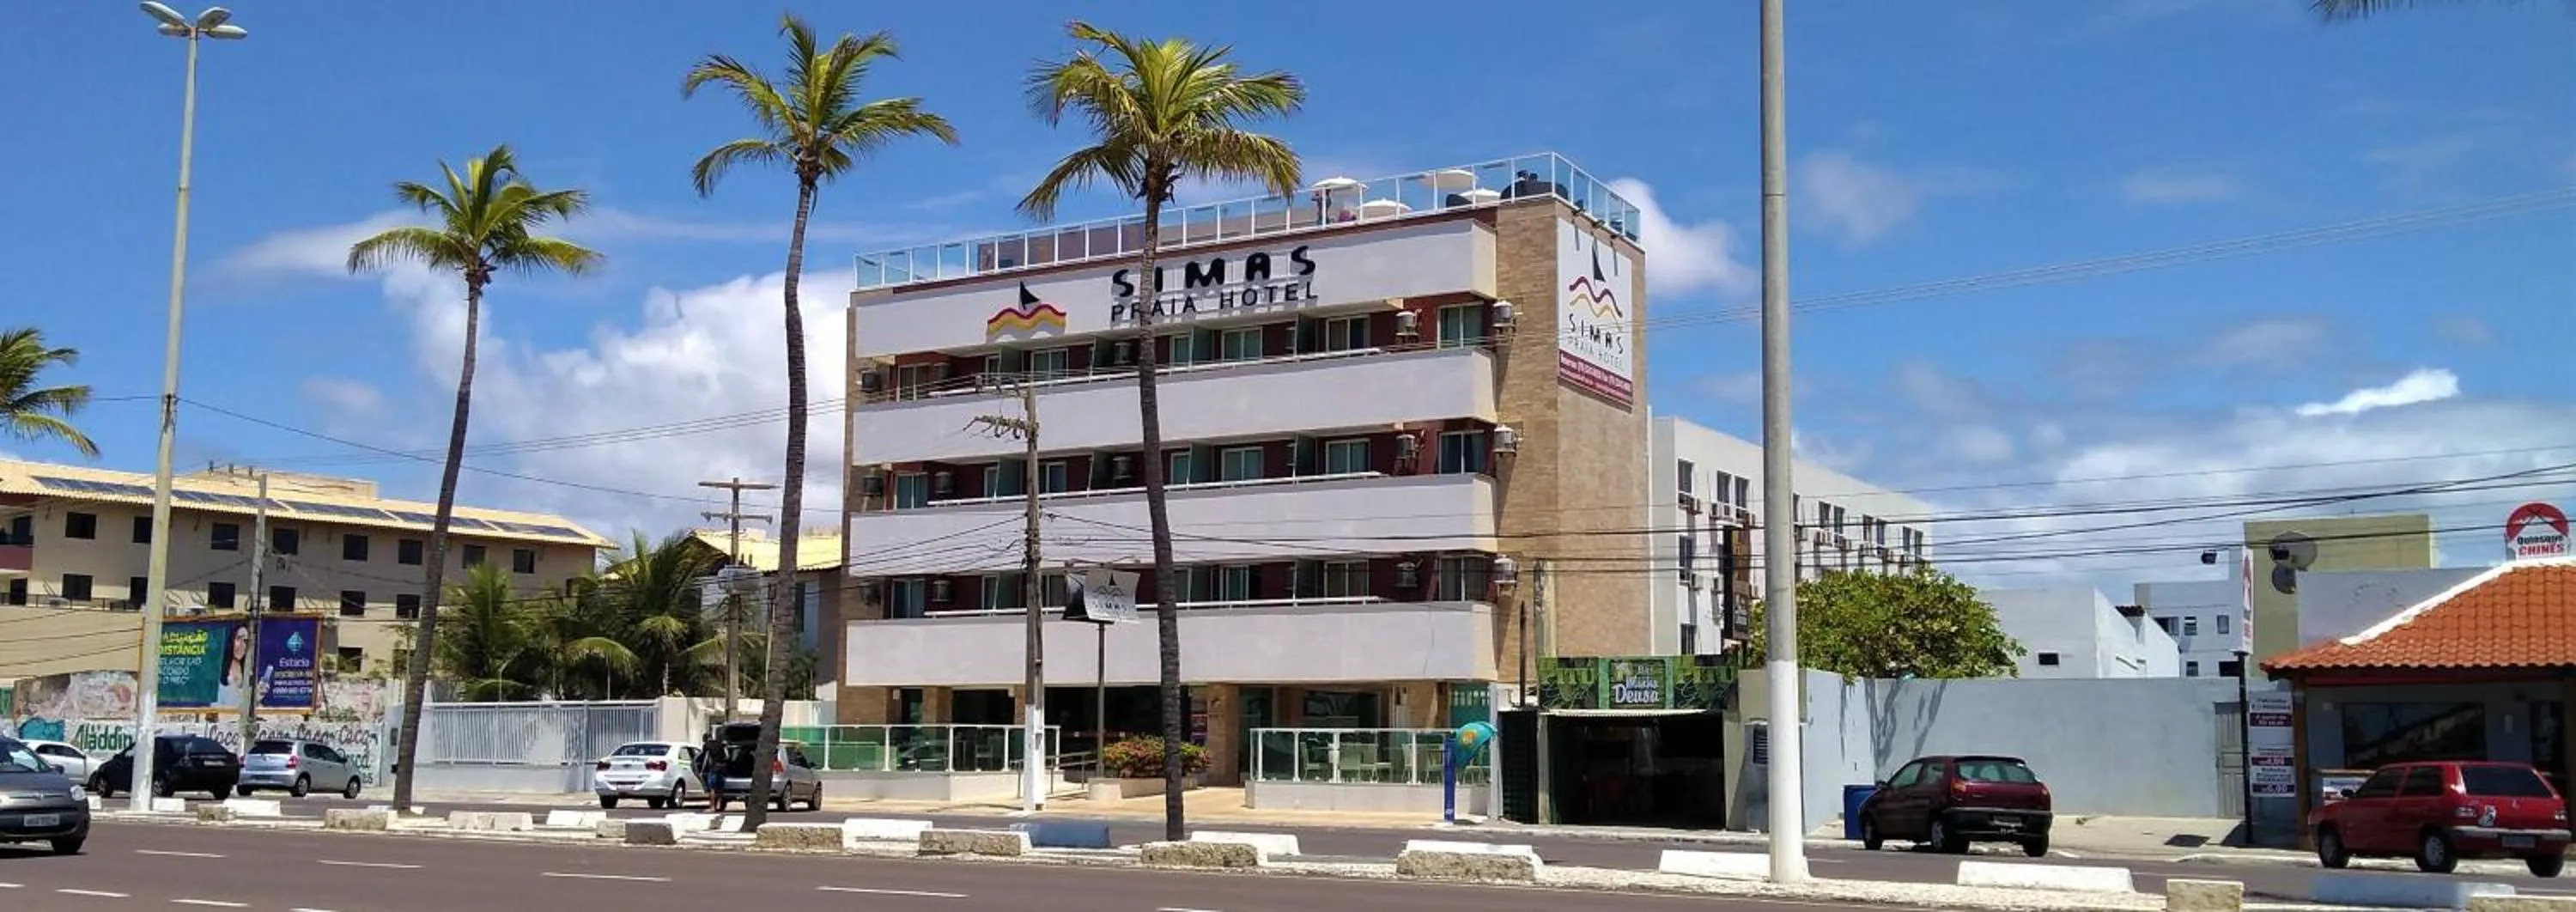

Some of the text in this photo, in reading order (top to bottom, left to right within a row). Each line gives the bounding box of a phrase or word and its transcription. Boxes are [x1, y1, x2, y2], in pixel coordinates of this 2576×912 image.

[1112, 245, 1316, 298] SIMAS
[1111, 281, 1319, 322] PRAIA HOTEL
[1568, 313, 1625, 355] SIMAS
[1612, 684, 1660, 703] Deusa
